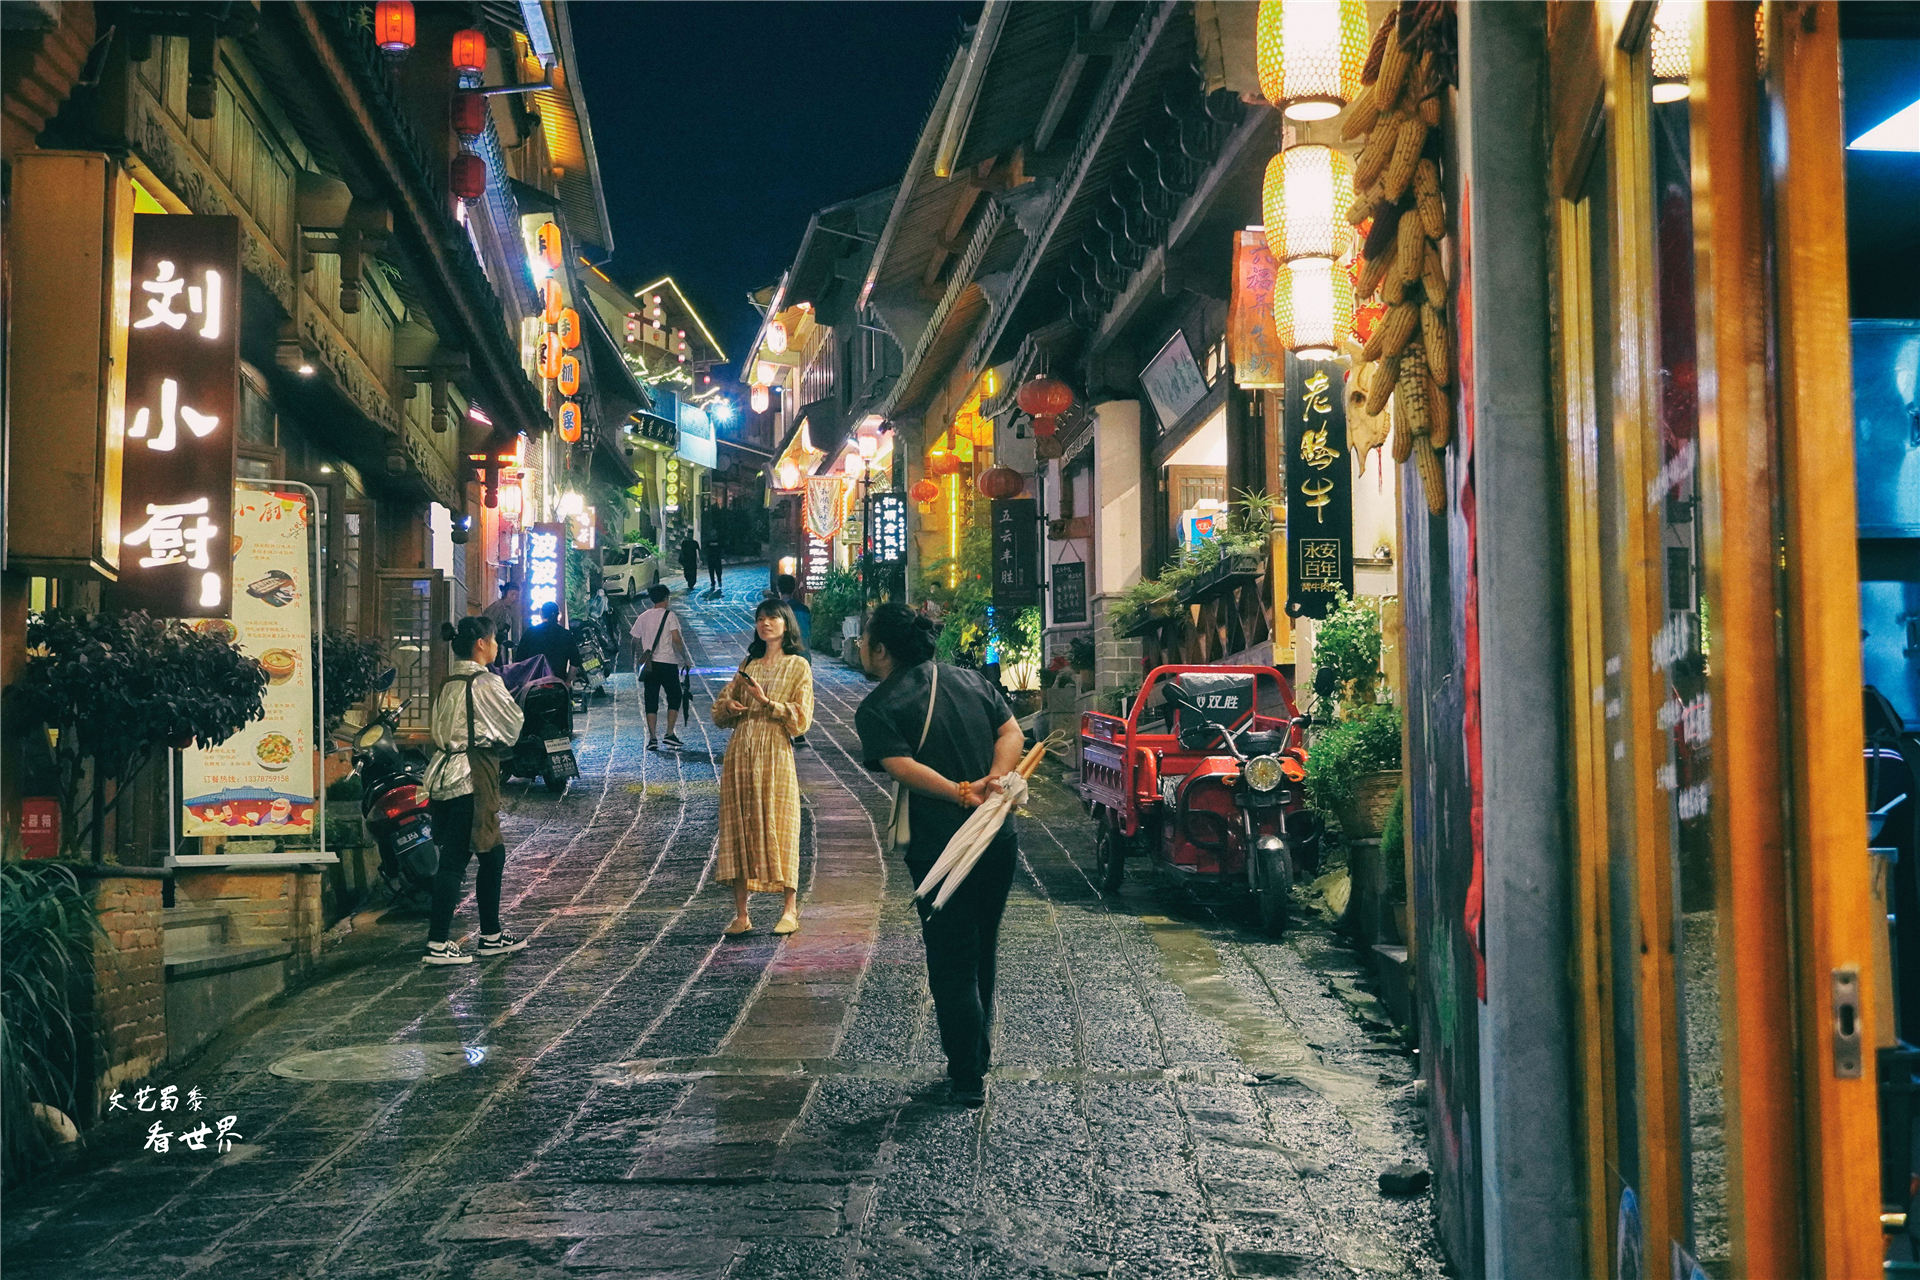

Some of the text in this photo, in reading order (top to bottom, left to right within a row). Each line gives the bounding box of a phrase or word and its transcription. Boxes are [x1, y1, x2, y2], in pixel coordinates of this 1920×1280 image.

[1246, 239, 1276, 376] 六福养生坊
[561, 318, 575, 429] 手抓宴
[124, 260, 221, 569] 刘小厨
[1304, 542, 1338, 558] 永安
[1305, 560, 1338, 577] 百年
[1207, 695, 1239, 709] 双胜
